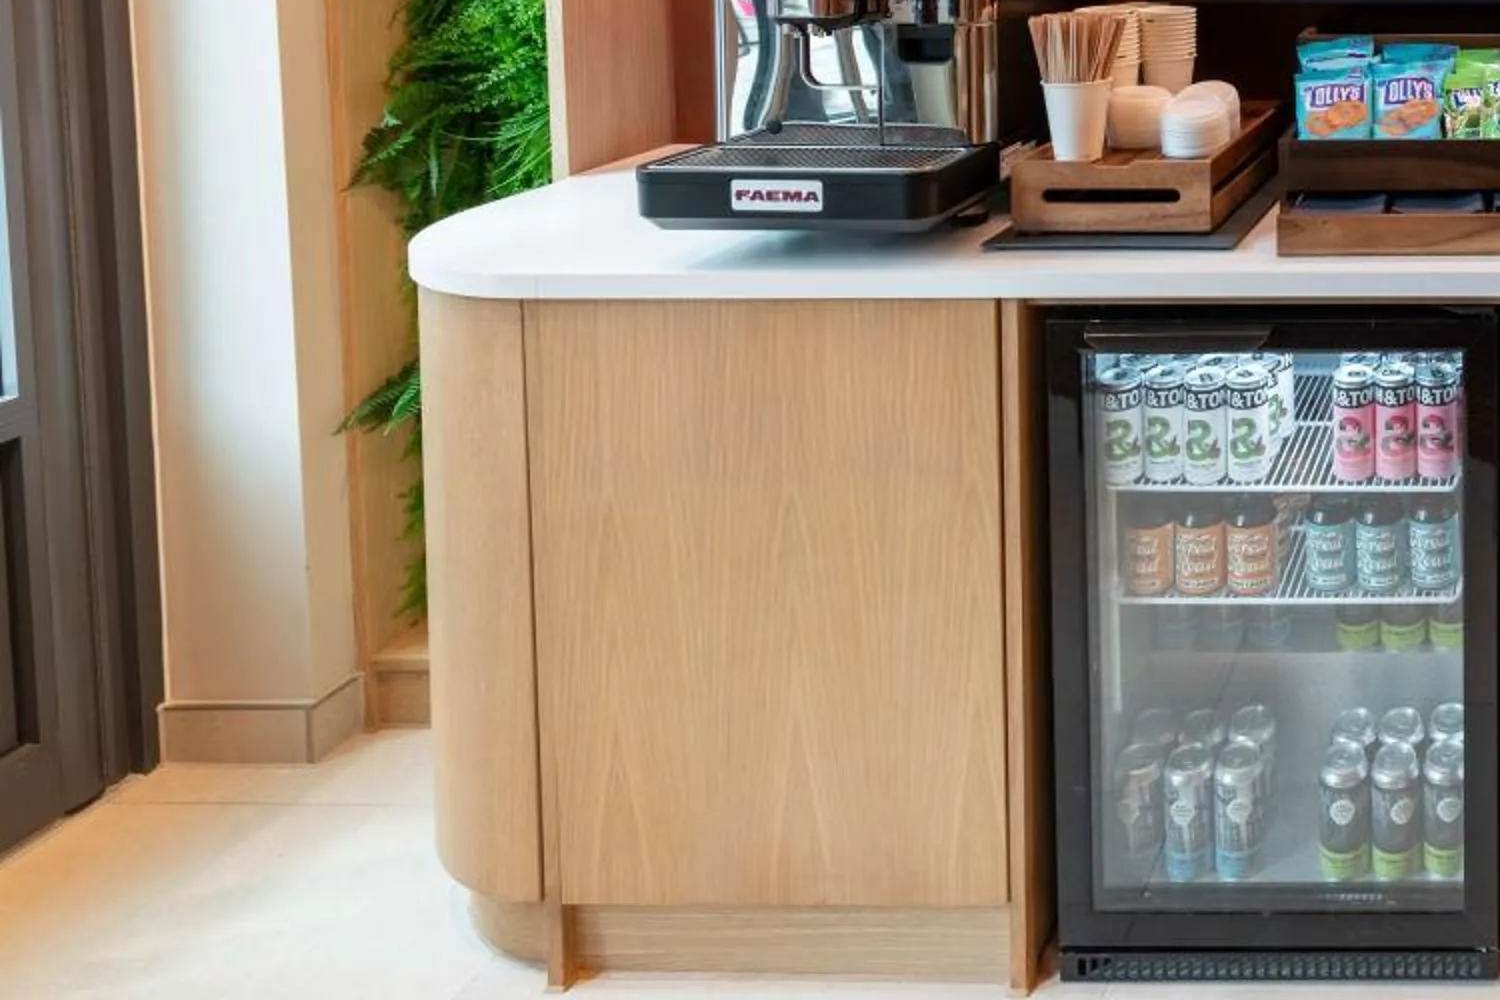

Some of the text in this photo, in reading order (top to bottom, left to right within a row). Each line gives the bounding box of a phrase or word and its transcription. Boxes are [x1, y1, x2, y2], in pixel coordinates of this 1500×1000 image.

[1315, 86, 1361, 105] OLLY'S
[1389, 79, 1433, 101] OLLY'S
[735, 189, 820, 203] FAEMA
